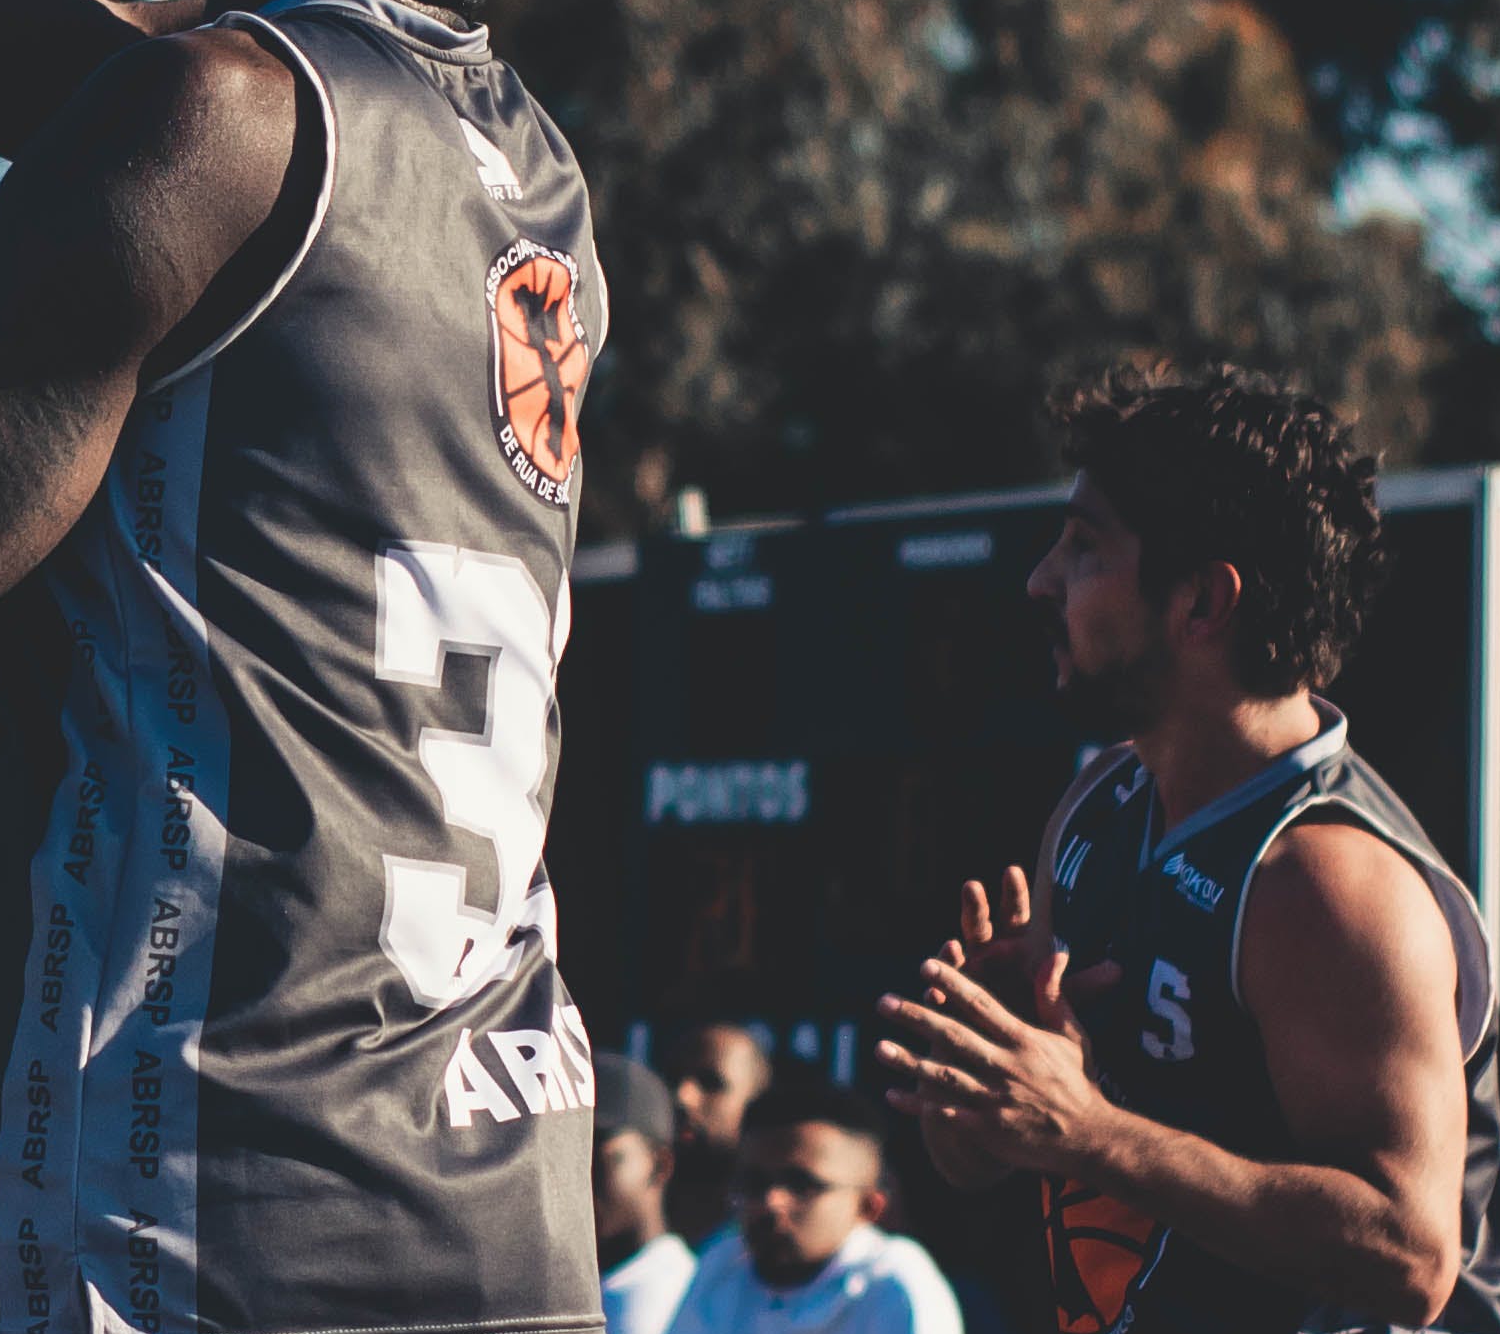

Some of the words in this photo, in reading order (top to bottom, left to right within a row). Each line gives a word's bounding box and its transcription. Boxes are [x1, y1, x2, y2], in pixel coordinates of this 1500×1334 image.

[499, 423, 520, 458] DE
[511, 450, 539, 490] RUA
[536, 476, 557, 502] DE
[63, 761, 109, 886] ABRSP
[162, 744, 196, 871] ABRSP
[375, 539, 557, 1008] 3
[40, 903, 75, 1033] ABRSP
[142, 897, 182, 1027] ABRSP
[21, 1059, 52, 1191] ABRSP
[129, 1049, 163, 1180] ABRSP
